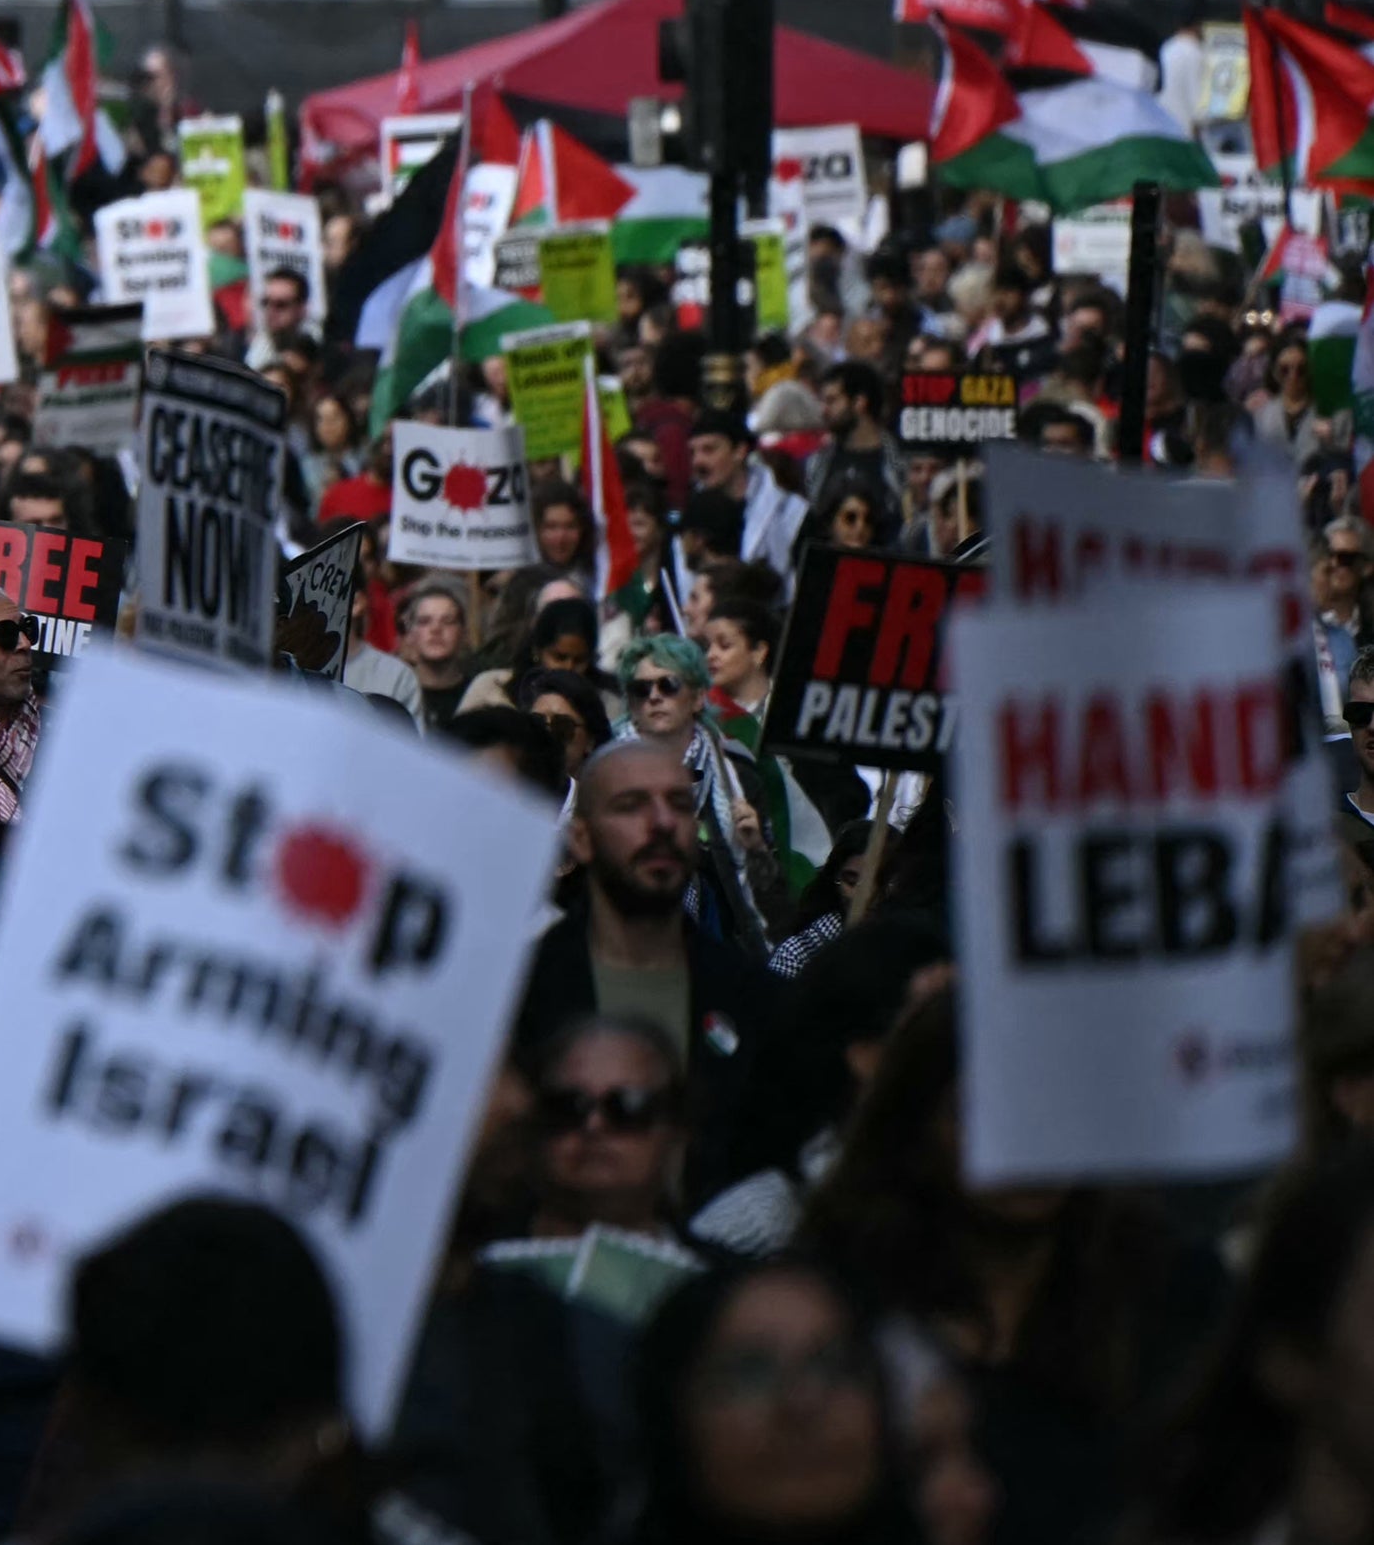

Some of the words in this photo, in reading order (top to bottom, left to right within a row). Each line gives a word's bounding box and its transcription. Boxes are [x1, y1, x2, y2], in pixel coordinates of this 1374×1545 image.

[117, 218, 182, 239] Stp
[899, 406, 1017, 442] GENOCIDE
[812, 556, 987, 691] FR
[997, 679, 1285, 814] HAND
[112, 757, 456, 980] Stp
[50, 898, 434, 1128] Arming
[40, 1016, 394, 1230] Israel
